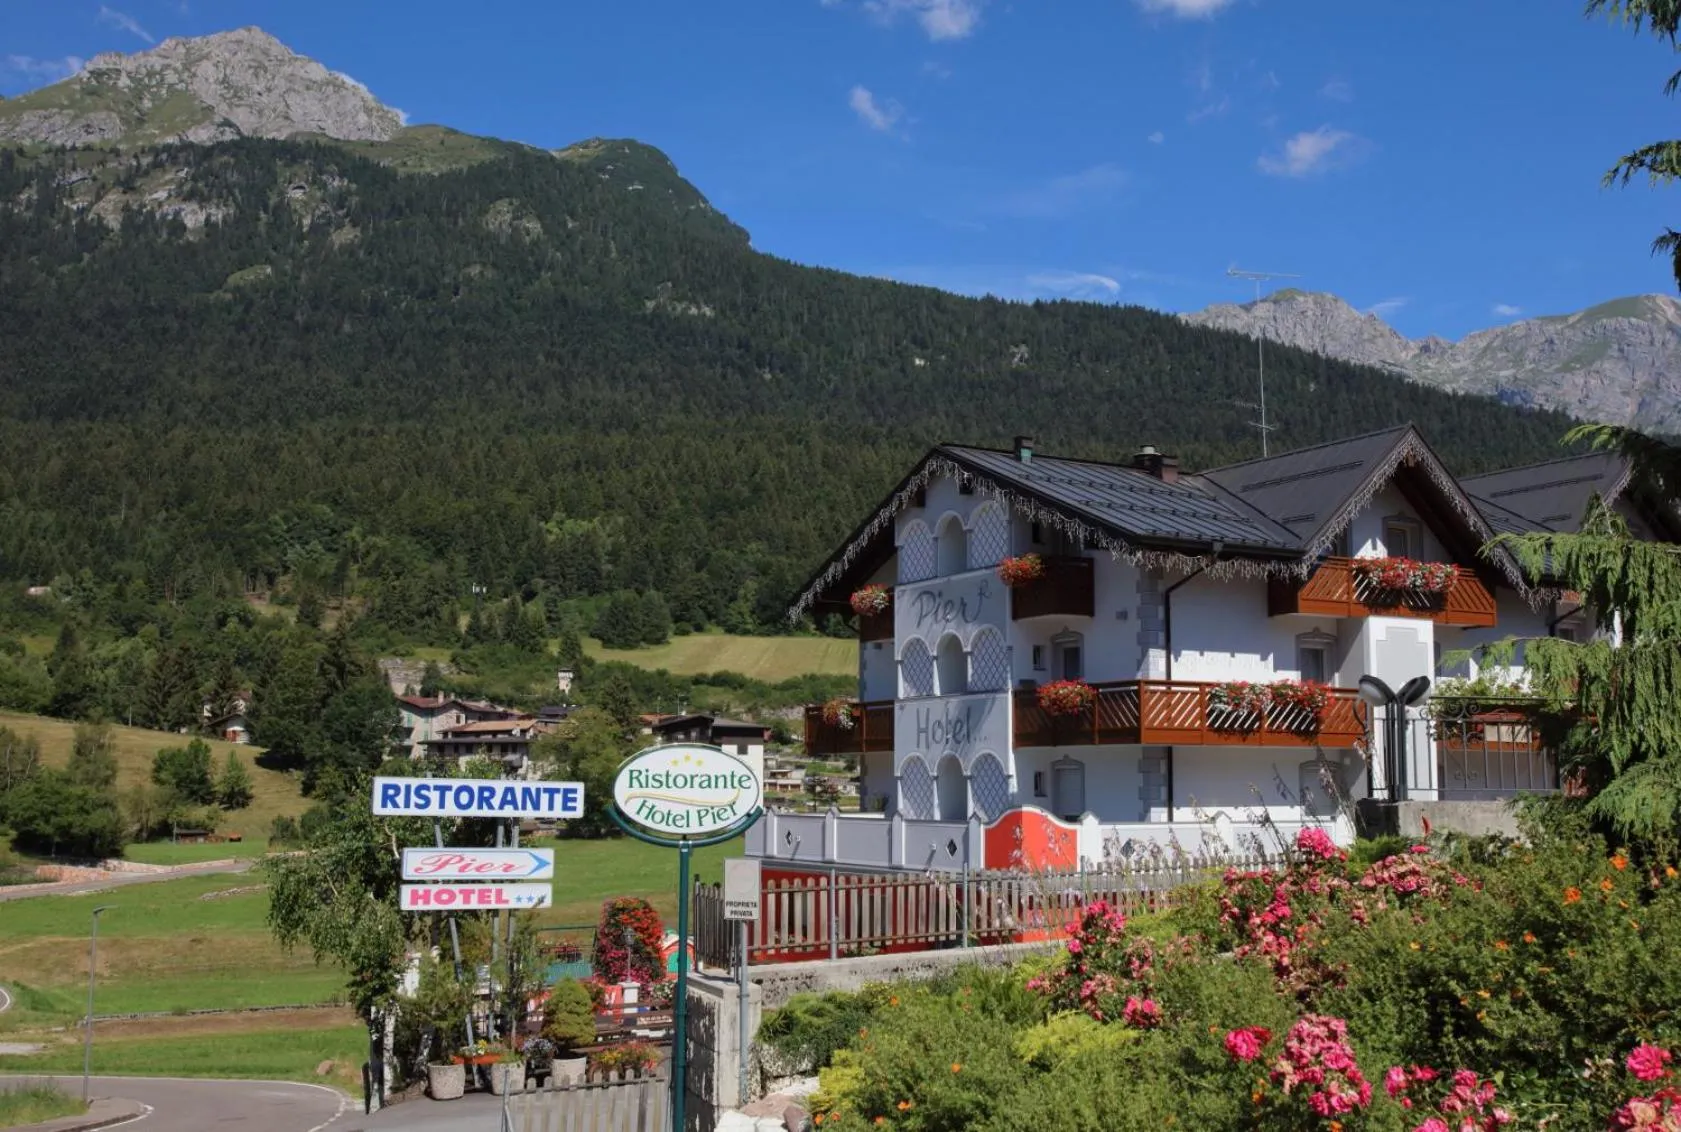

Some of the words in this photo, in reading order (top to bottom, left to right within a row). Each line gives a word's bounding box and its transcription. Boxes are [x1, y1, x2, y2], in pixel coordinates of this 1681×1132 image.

[911, 578, 993, 629] Pier
[916, 706, 972, 750] Hotel
[628, 769, 751, 789] Ristorante
[381, 783, 578, 812] RISTORANTE
[636, 799, 690, 828] Hotel
[697, 801, 737, 827] Pier
[413, 853, 527, 874] Pier
[410, 888, 510, 906] HOTEL
